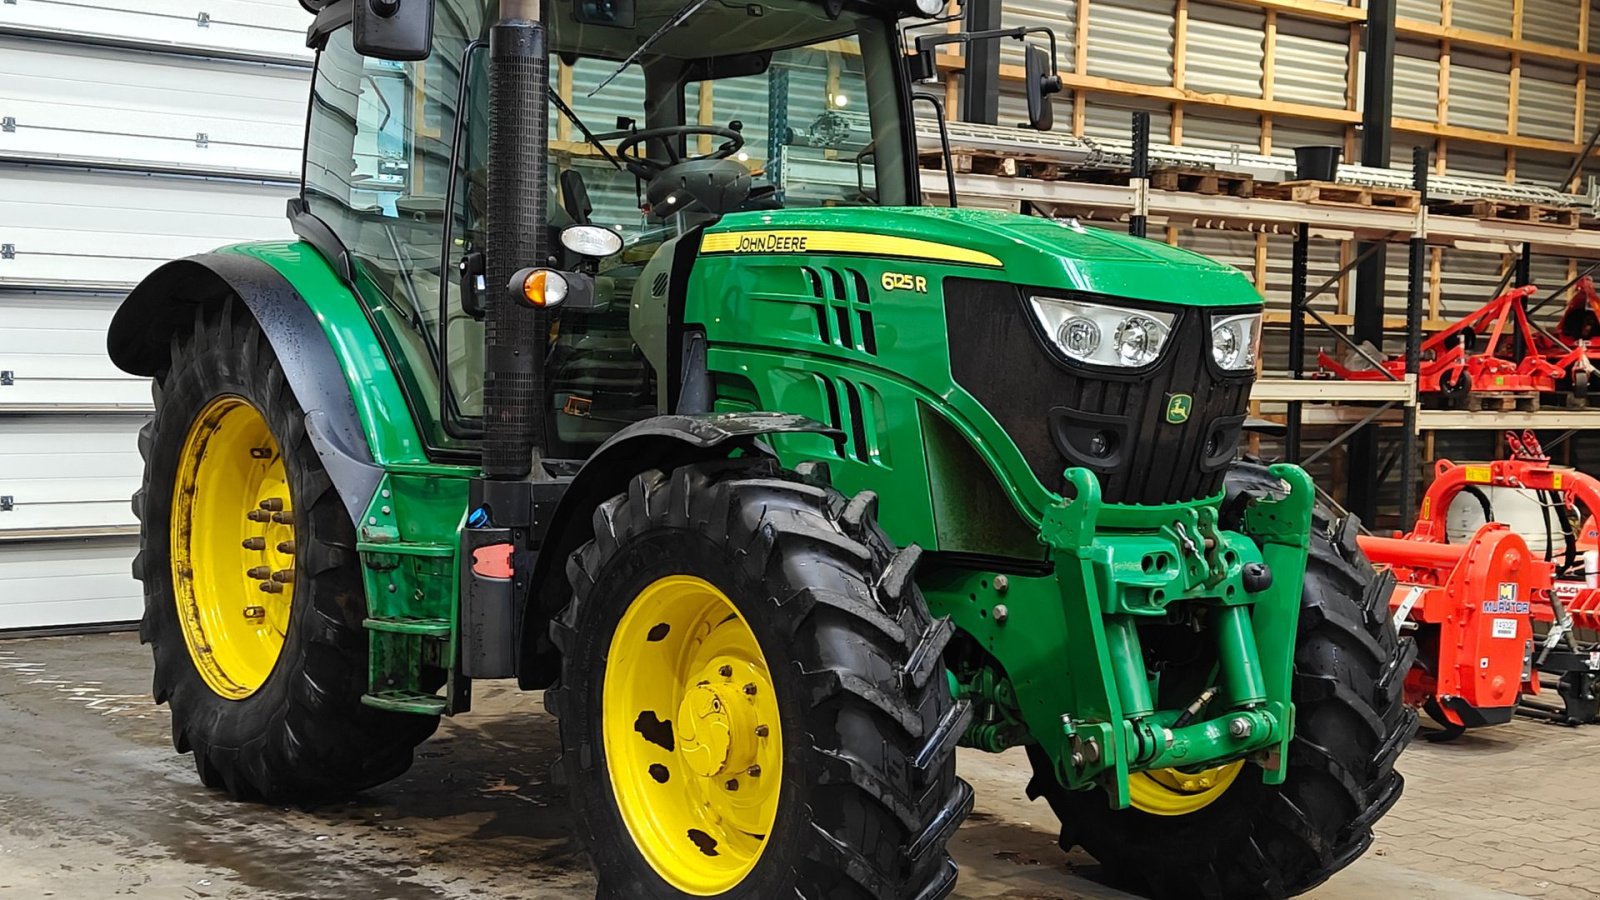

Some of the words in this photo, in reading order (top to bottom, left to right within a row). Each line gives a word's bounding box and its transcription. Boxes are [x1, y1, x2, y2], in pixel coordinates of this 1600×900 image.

[735, 235, 766, 250] JOHN
[767, 234, 807, 250] DEERE
[881, 271, 914, 291] 6125
[1484, 602, 1529, 613] MURATOR
